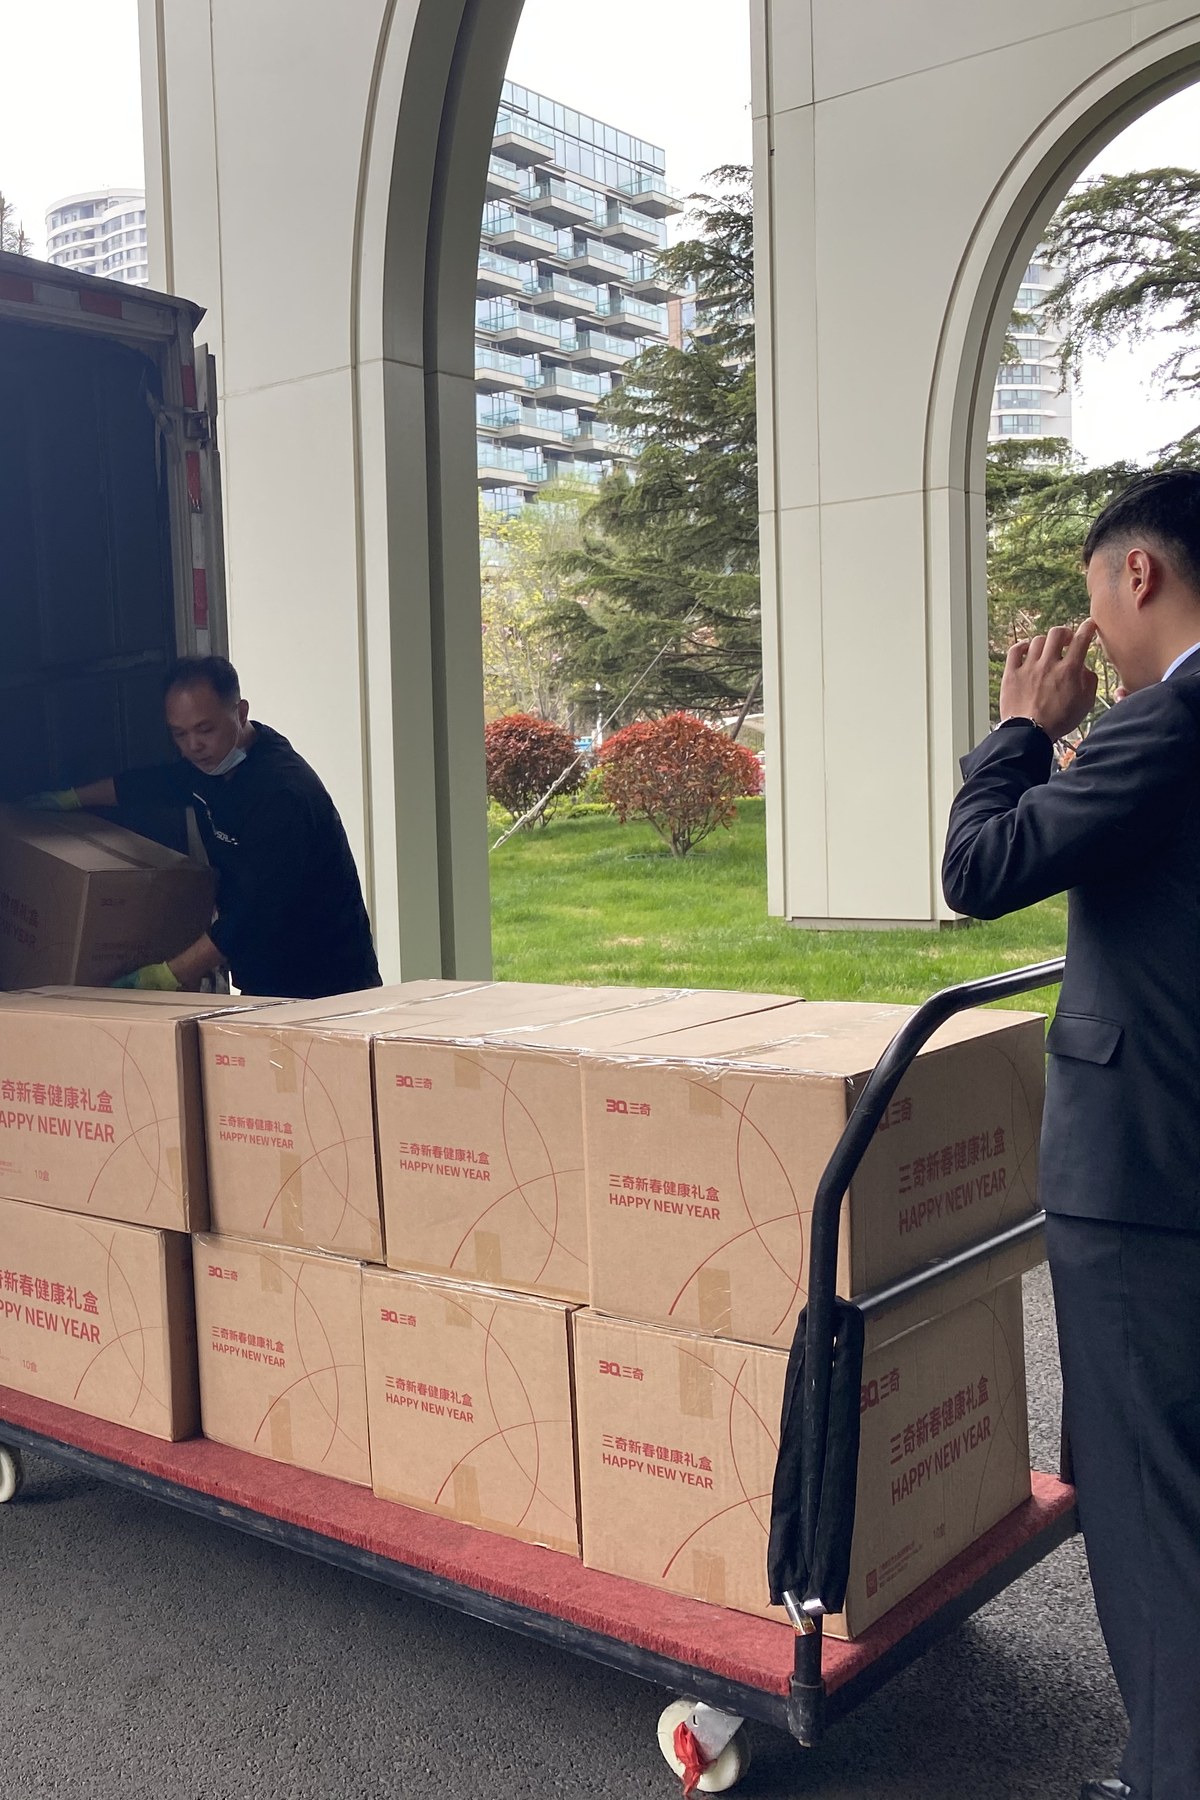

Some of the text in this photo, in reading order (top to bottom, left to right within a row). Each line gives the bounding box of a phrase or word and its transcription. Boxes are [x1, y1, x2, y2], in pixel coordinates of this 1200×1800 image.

[37, 1115, 72, 1137] NEW
[74, 1120, 115, 1143] YEAR
[219, 1115, 293, 1135] 三奇新春健康礼盒
[220, 1132, 294, 1149] HAPPY NEW YEAR
[399, 1142, 489, 1165] 三奇新春健康礼盒
[400, 1159, 491, 1182] HAPPY NEW YEAR
[899, 1125, 1005, 1194] 三奇新春健康礼盒
[609, 1174, 720, 1202] 三奇新春健康礼盒
[899, 1167, 1007, 1235] HAPPY NEW YEAR
[609, 1193, 721, 1220] HAPPY NEW YEAR
[26, 1306, 59, 1332] NEW
[62, 1316, 101, 1343] YEAR
[212, 1326, 285, 1354] 三奇新春健康礼盒
[212, 1341, 286, 1368] HAPPY NEW YEAR
[385, 1375, 473, 1407] 三奇新春健康礼盒
[386, 1392, 474, 1423] HAPPY NEW YEAR
[890, 1375, 989, 1465] 三奇新春健康礼盒
[603, 1434, 712, 1472] 三奇新春健康礼盒
[891, 1415, 991, 1506] HAPPY NEW YEAR
[603, 1452, 714, 1489] HAPPY NEW YEAR
